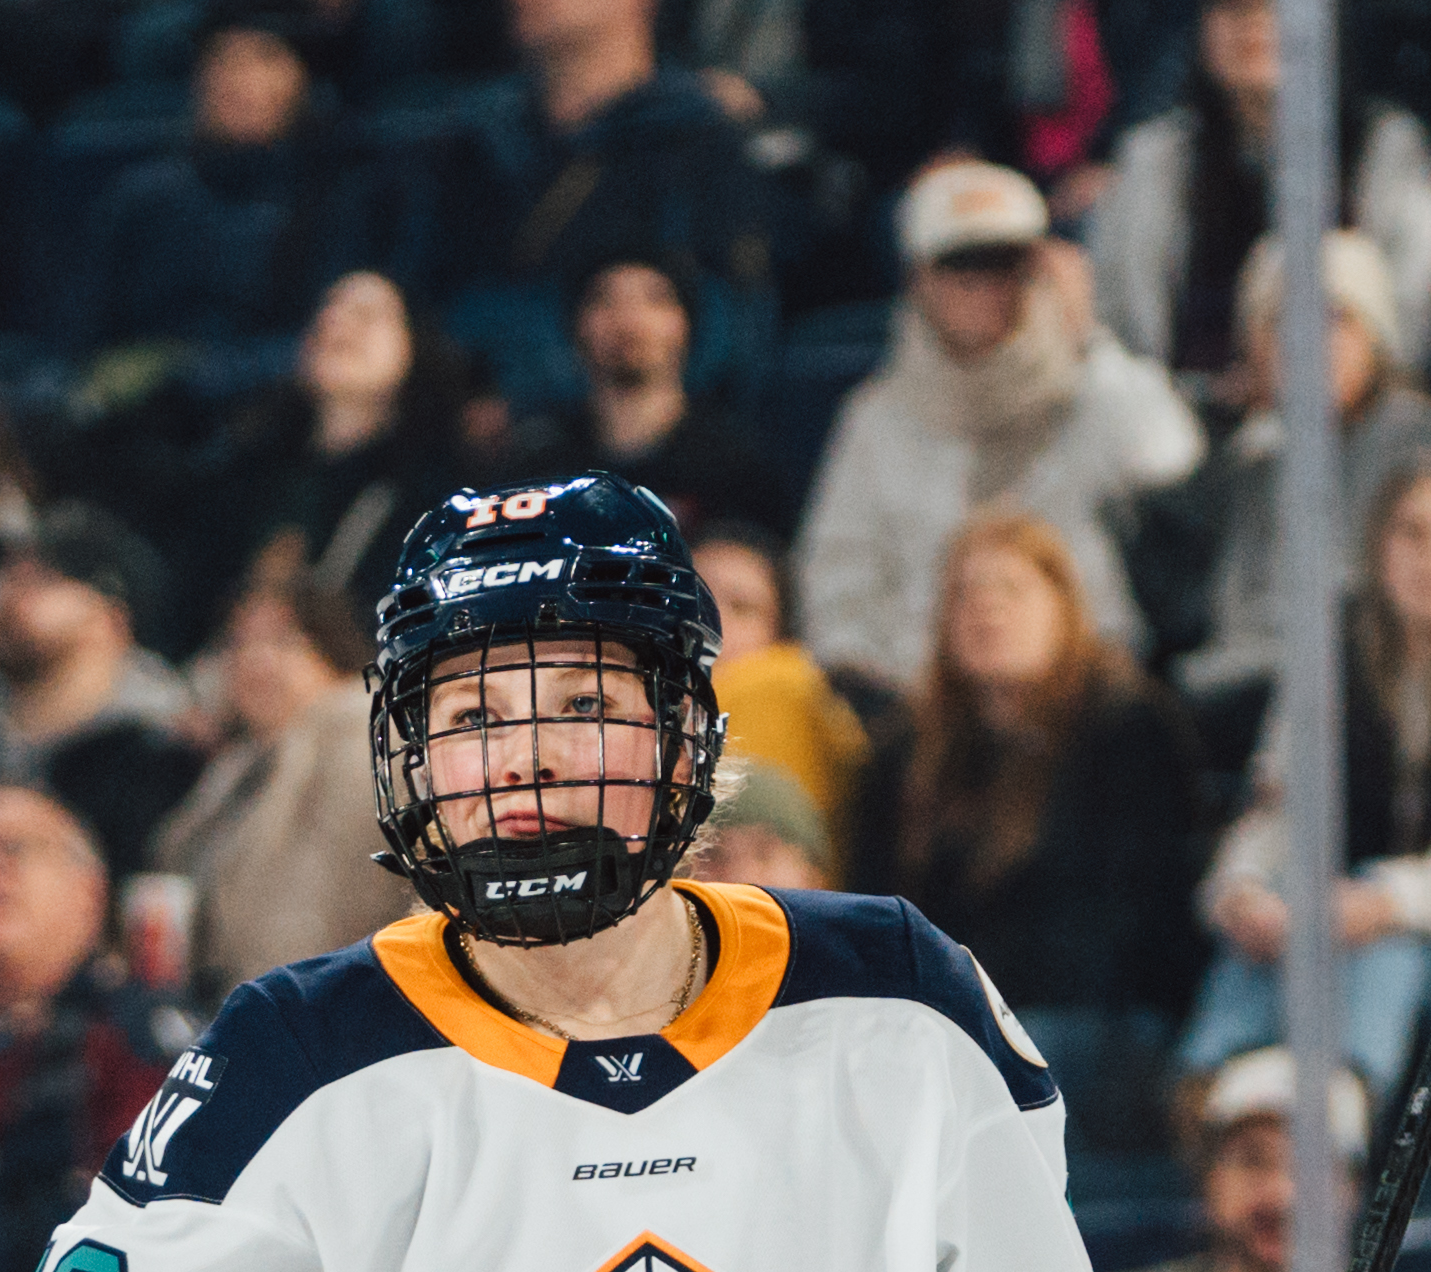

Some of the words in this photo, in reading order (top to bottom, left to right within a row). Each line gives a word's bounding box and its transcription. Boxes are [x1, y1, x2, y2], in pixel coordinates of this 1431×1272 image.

[466, 491, 552, 529] 10
[448, 558, 564, 594] CCM
[486, 871, 587, 899] CCM
